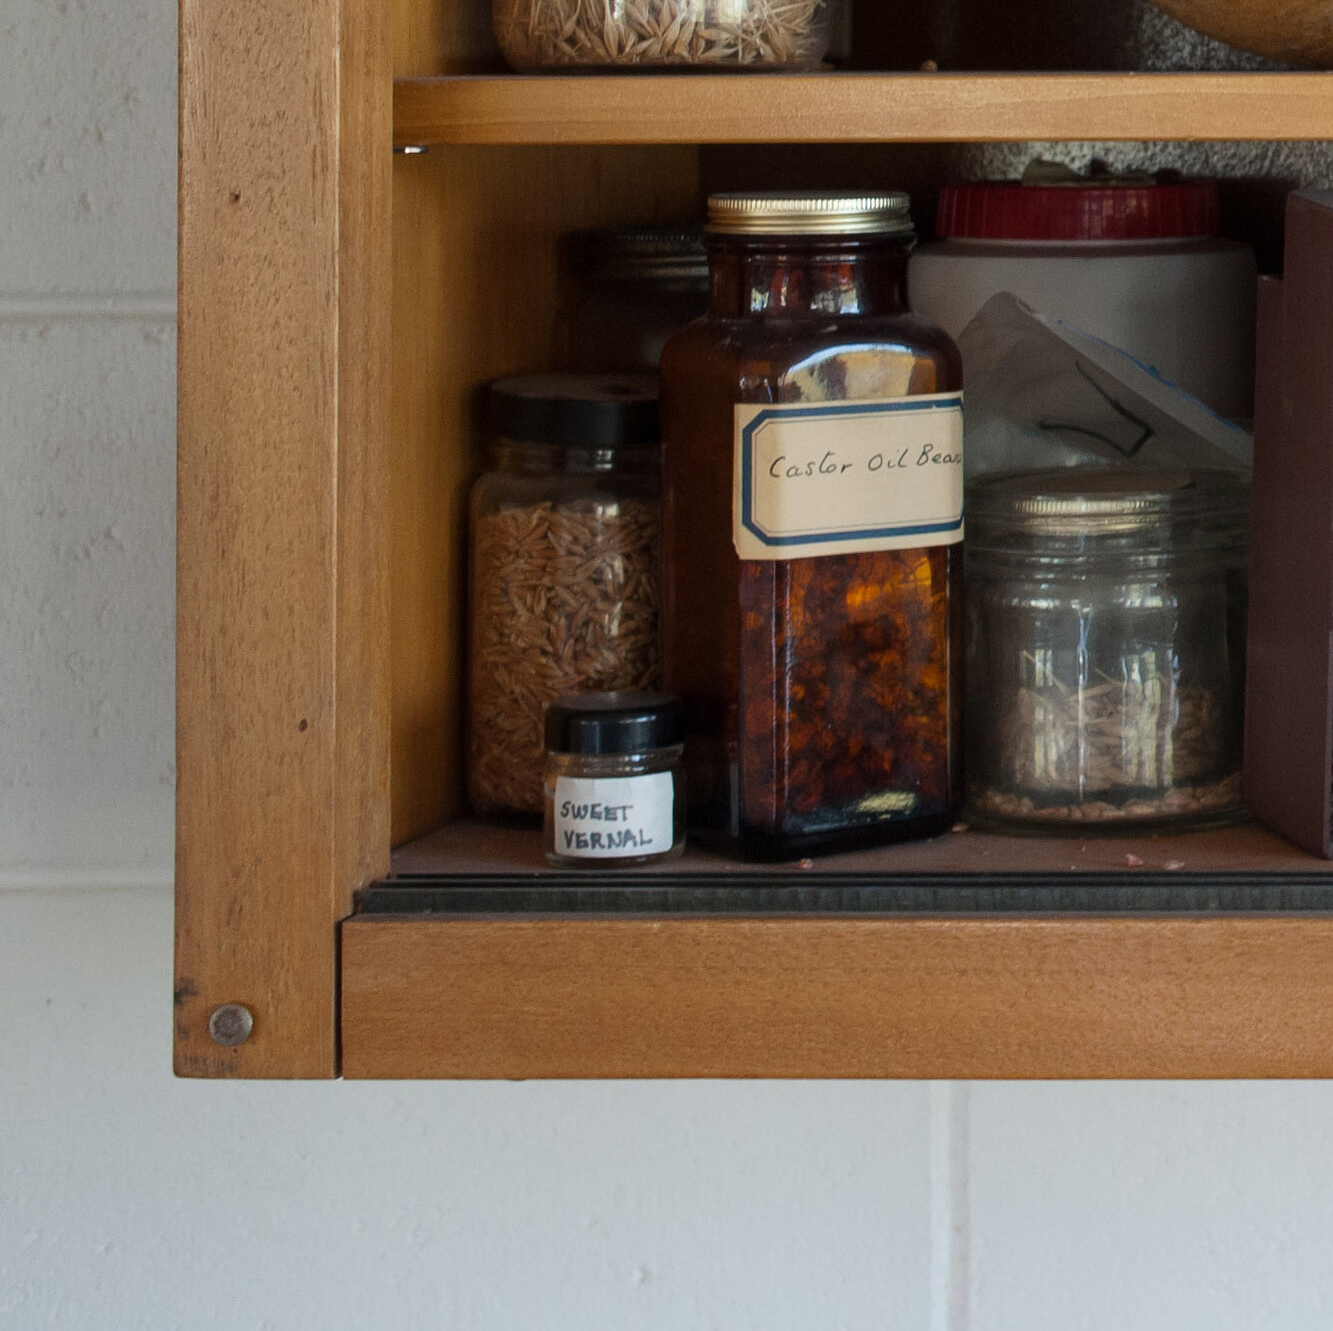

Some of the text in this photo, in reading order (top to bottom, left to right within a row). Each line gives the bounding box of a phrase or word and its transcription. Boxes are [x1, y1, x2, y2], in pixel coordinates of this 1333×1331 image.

[769, 450, 853, 479] Castor
[867, 448, 909, 471] Oil
[560, 800, 634, 821] SWEET
[563, 828, 653, 850] VERNAL
